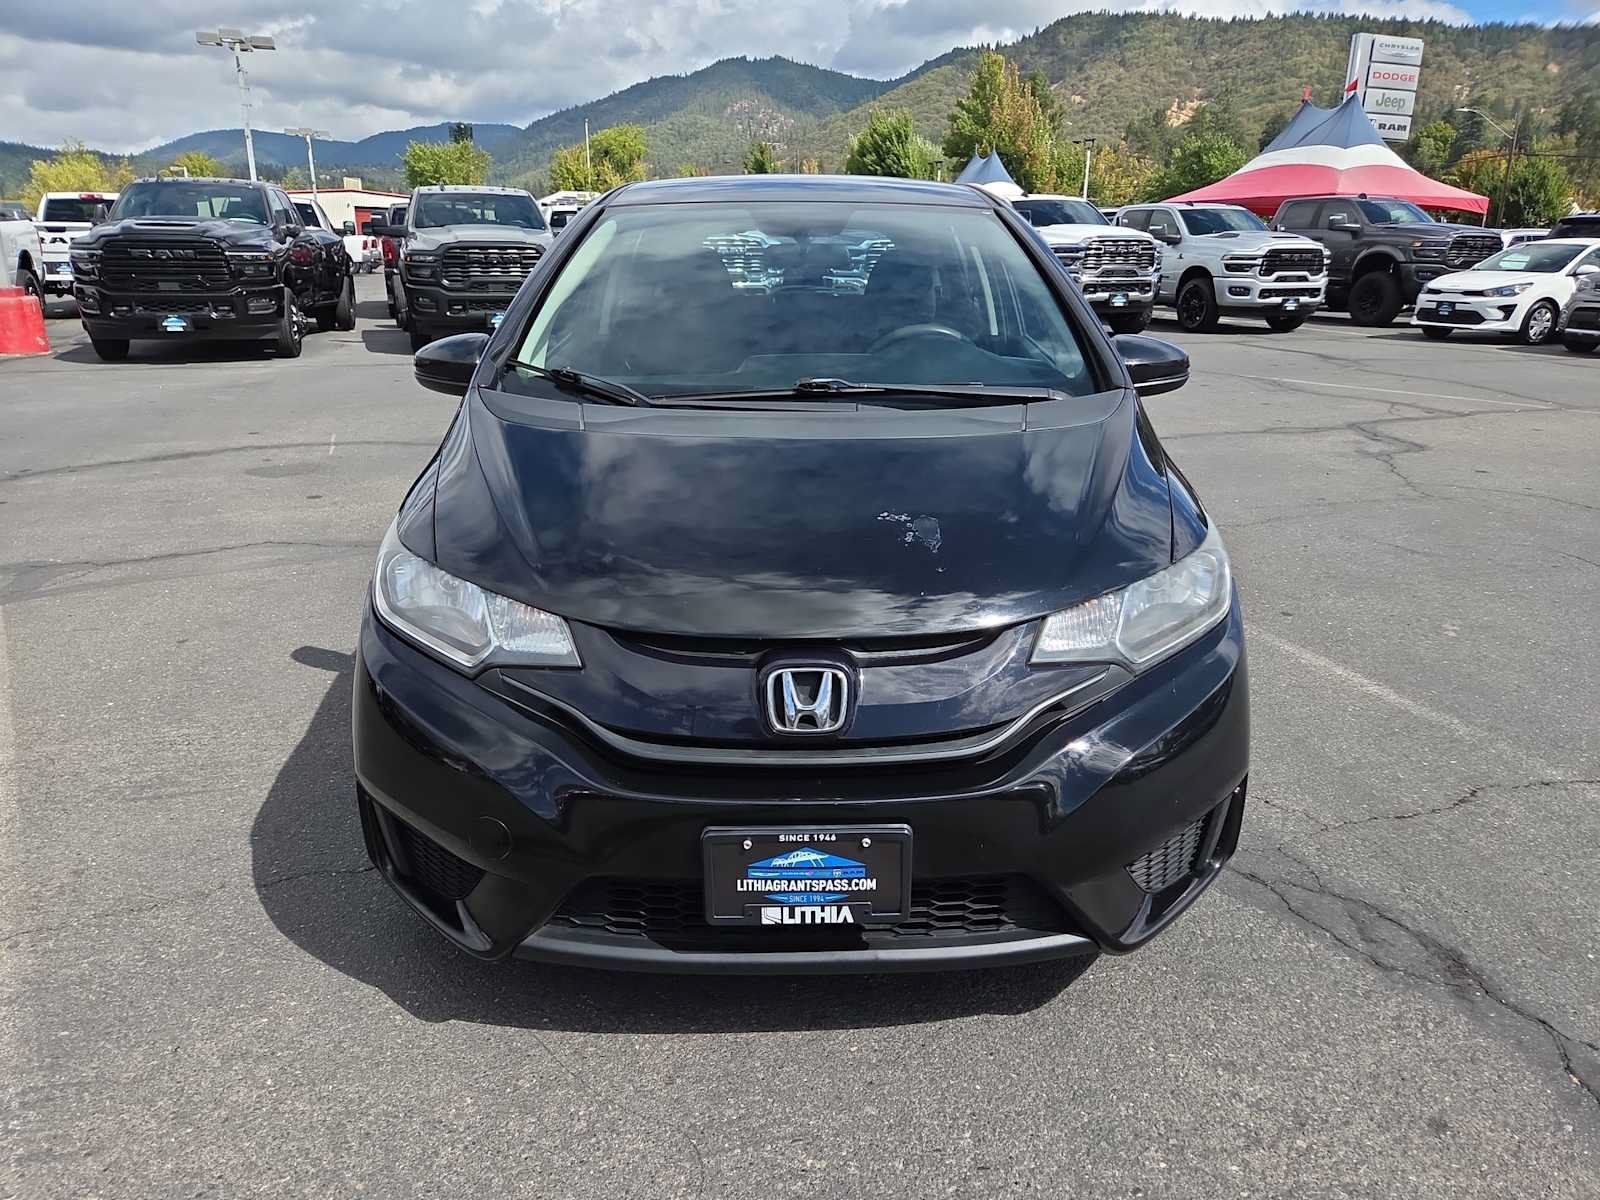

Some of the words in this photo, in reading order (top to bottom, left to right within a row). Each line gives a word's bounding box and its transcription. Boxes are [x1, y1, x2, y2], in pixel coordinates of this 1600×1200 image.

[1373, 71, 1416, 82] DODGE
[1376, 92, 1405, 111] Jeep
[1378, 123, 1407, 131] RAM
[779, 834, 810, 842] SINCE
[737, 879, 876, 891] LITHIAGRANTSPASS.COM
[789, 895, 807, 903] SINCE
[809, 895, 825, 903] 1994
[783, 906, 854, 924] LITHIA
